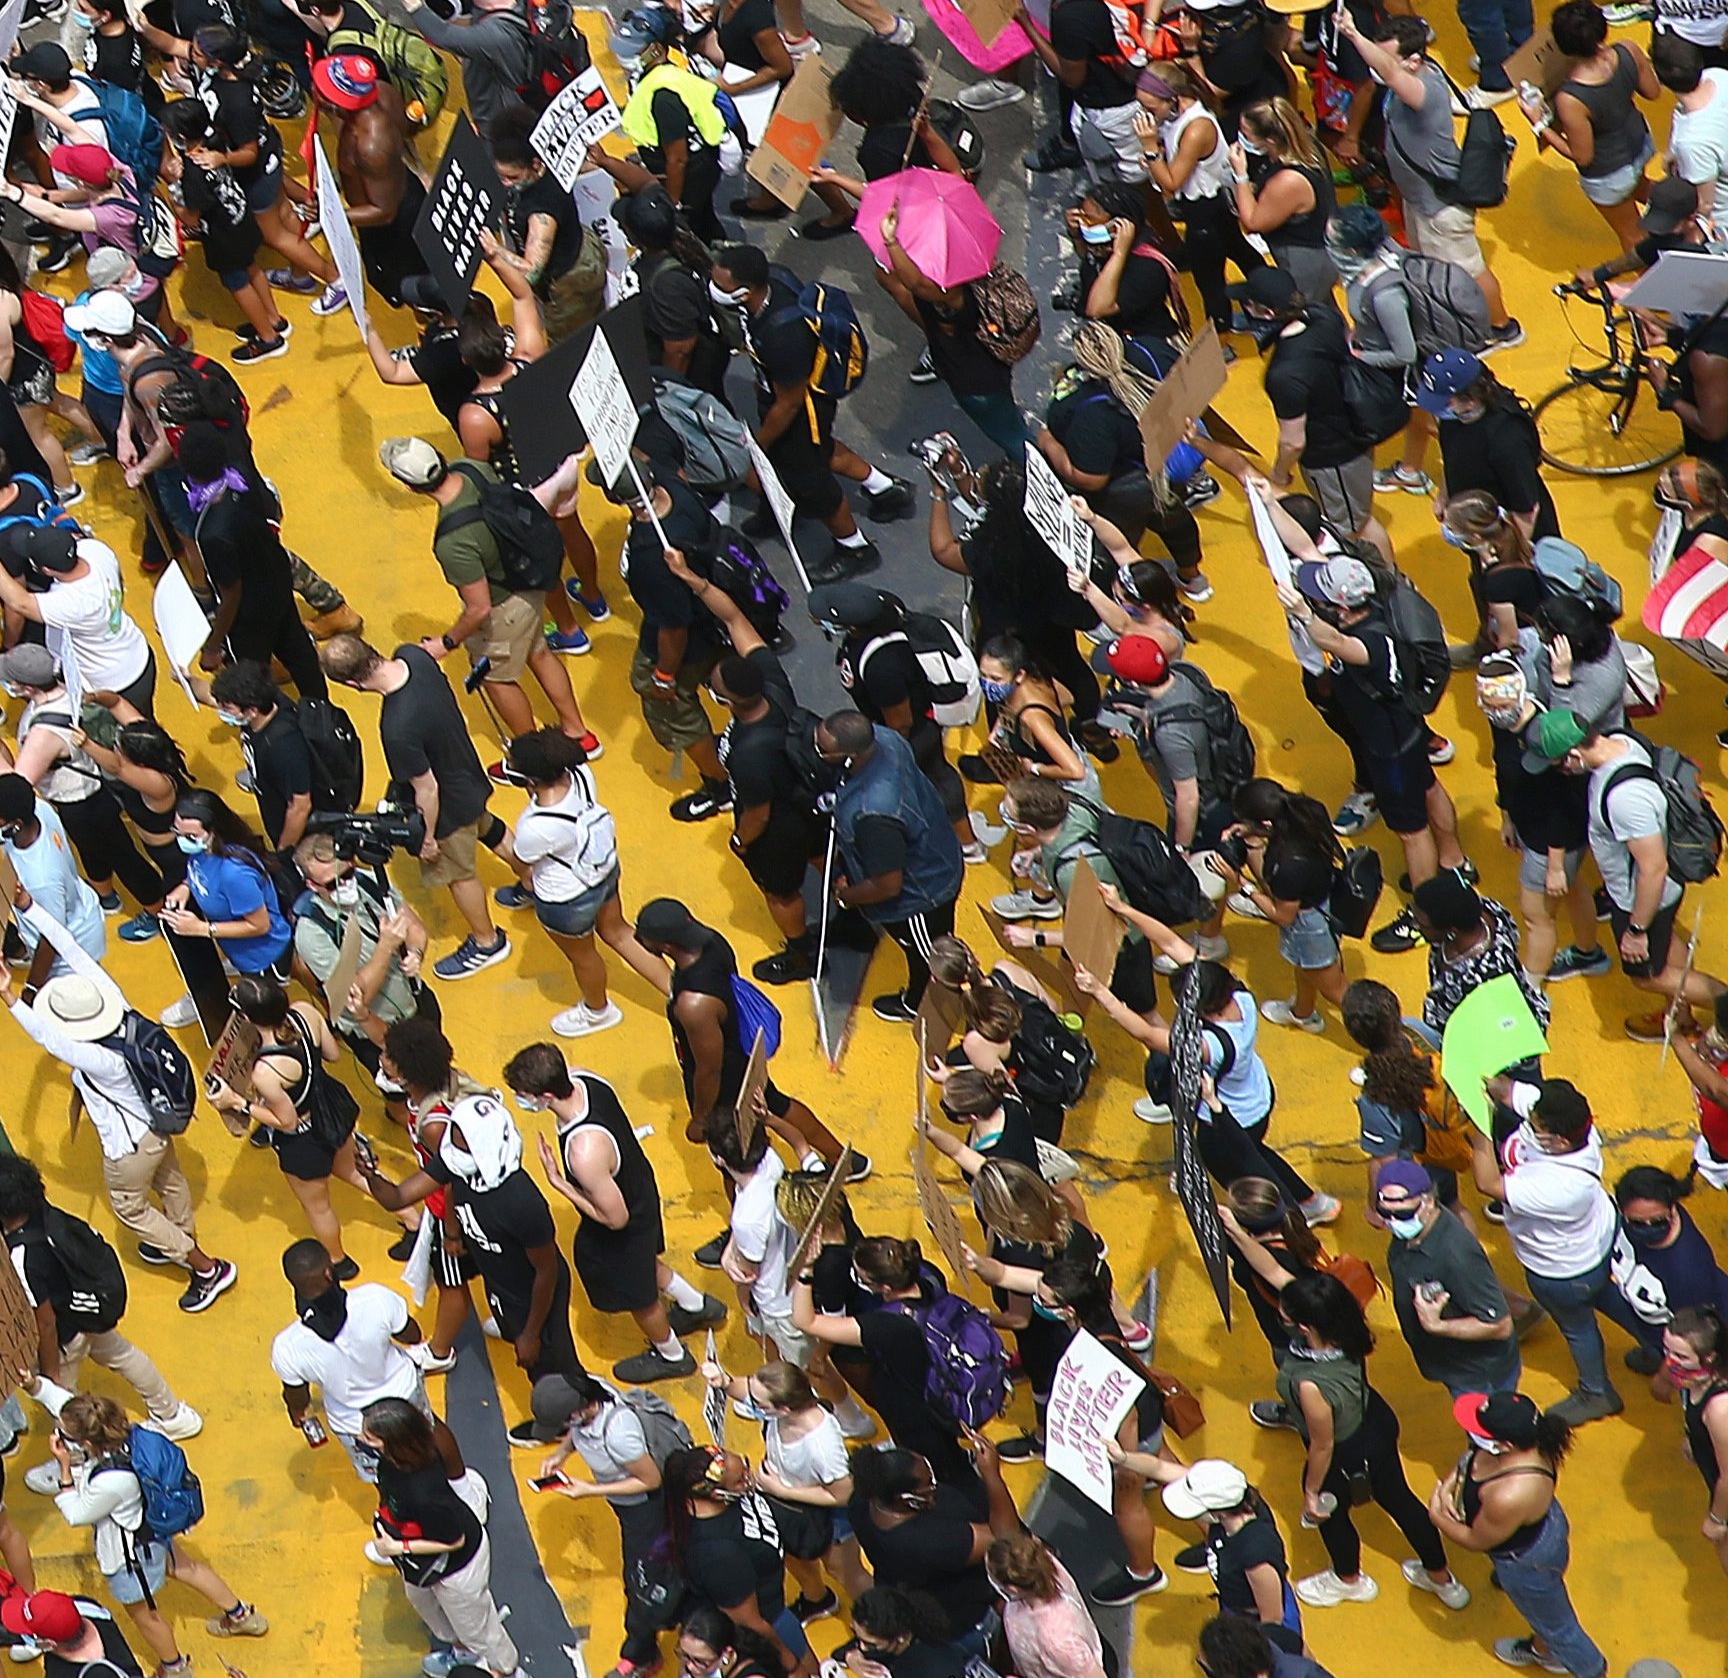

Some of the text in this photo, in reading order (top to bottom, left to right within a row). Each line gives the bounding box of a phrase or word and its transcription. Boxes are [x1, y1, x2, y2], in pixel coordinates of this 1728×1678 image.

[534, 83, 589, 149] BLACK
[546, 104, 589, 161] LIVES
[558, 108, 619, 187] MATTER
[430, 157, 466, 233] BLACK
[442, 180, 473, 255] LIVES
[453, 188, 493, 280] MATTER
[1050, 1358, 1082, 1450] BLACK
[1067, 1382, 1096, 1456] LIVES
[1086, 1370, 1132, 1488] MATTER
